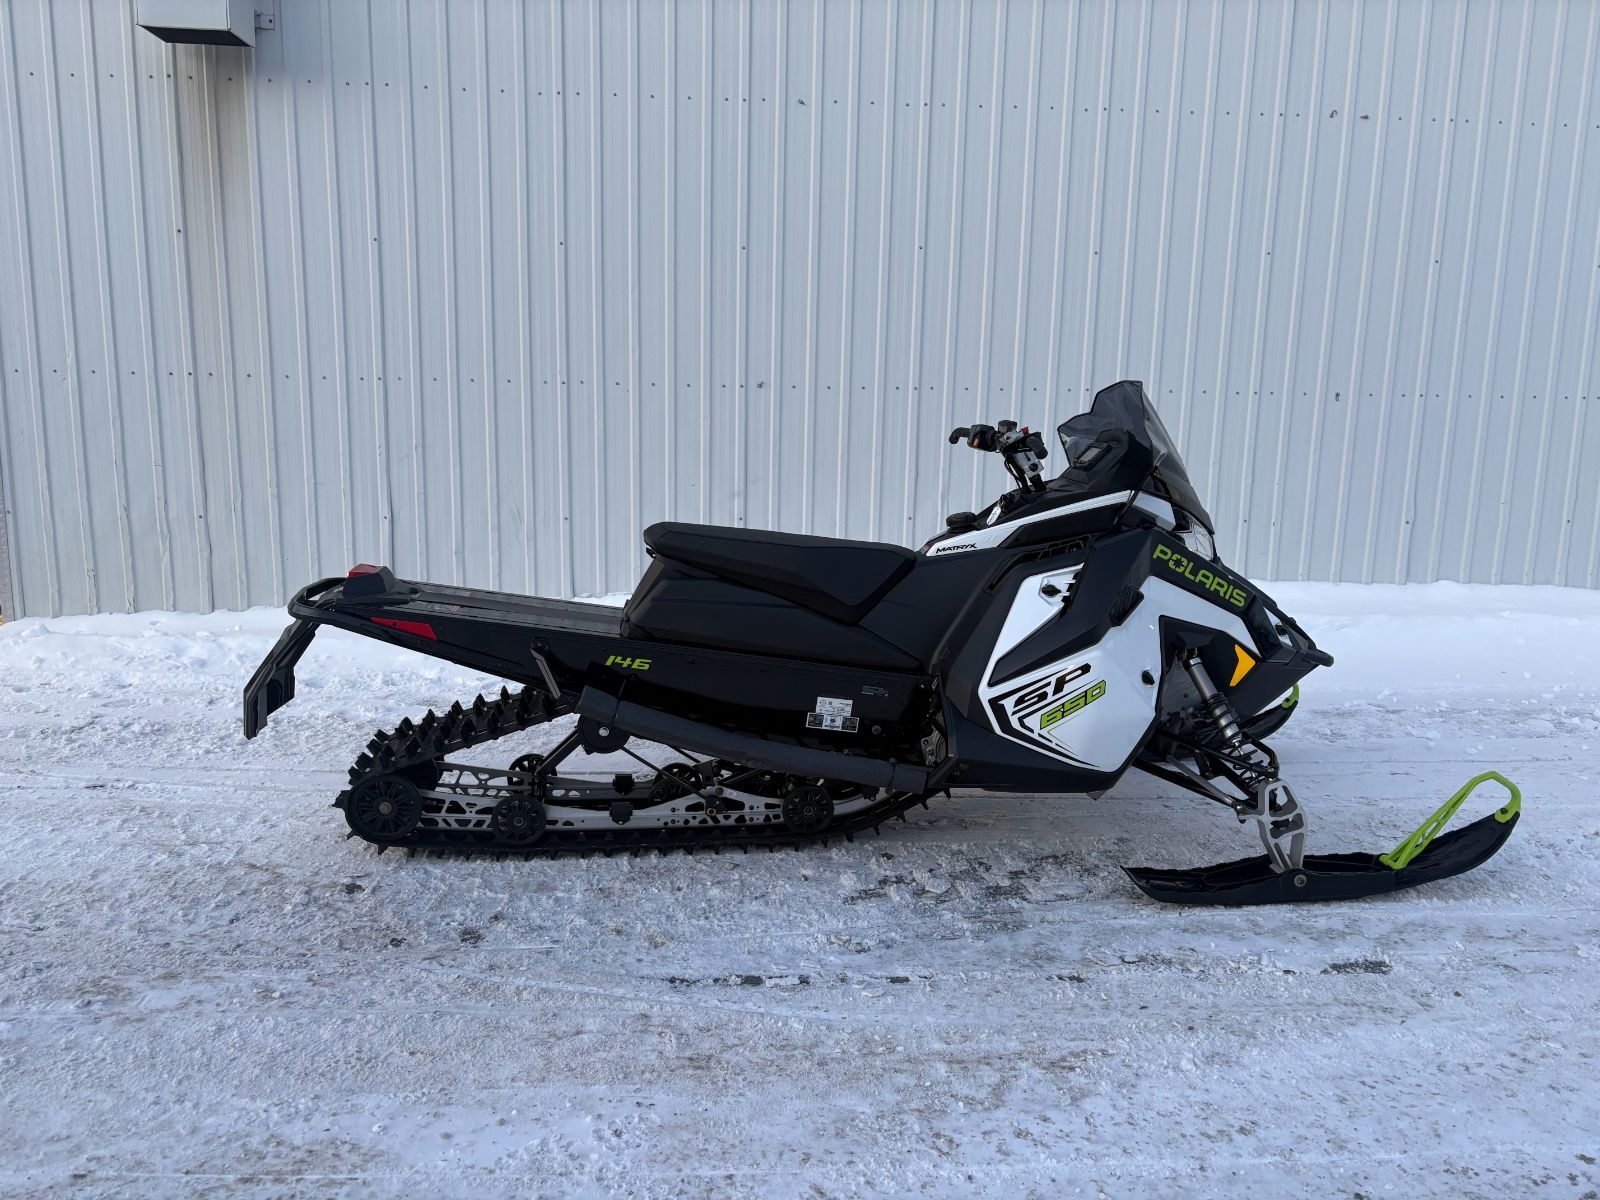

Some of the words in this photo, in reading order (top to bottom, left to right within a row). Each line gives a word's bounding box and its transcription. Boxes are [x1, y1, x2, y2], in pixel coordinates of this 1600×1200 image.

[936, 543, 977, 554] MATRYX
[1152, 543, 1247, 607] POLARIS
[605, 655, 652, 670] 146
[1011, 663, 1092, 717] SP
[1040, 679, 1107, 730] 650
